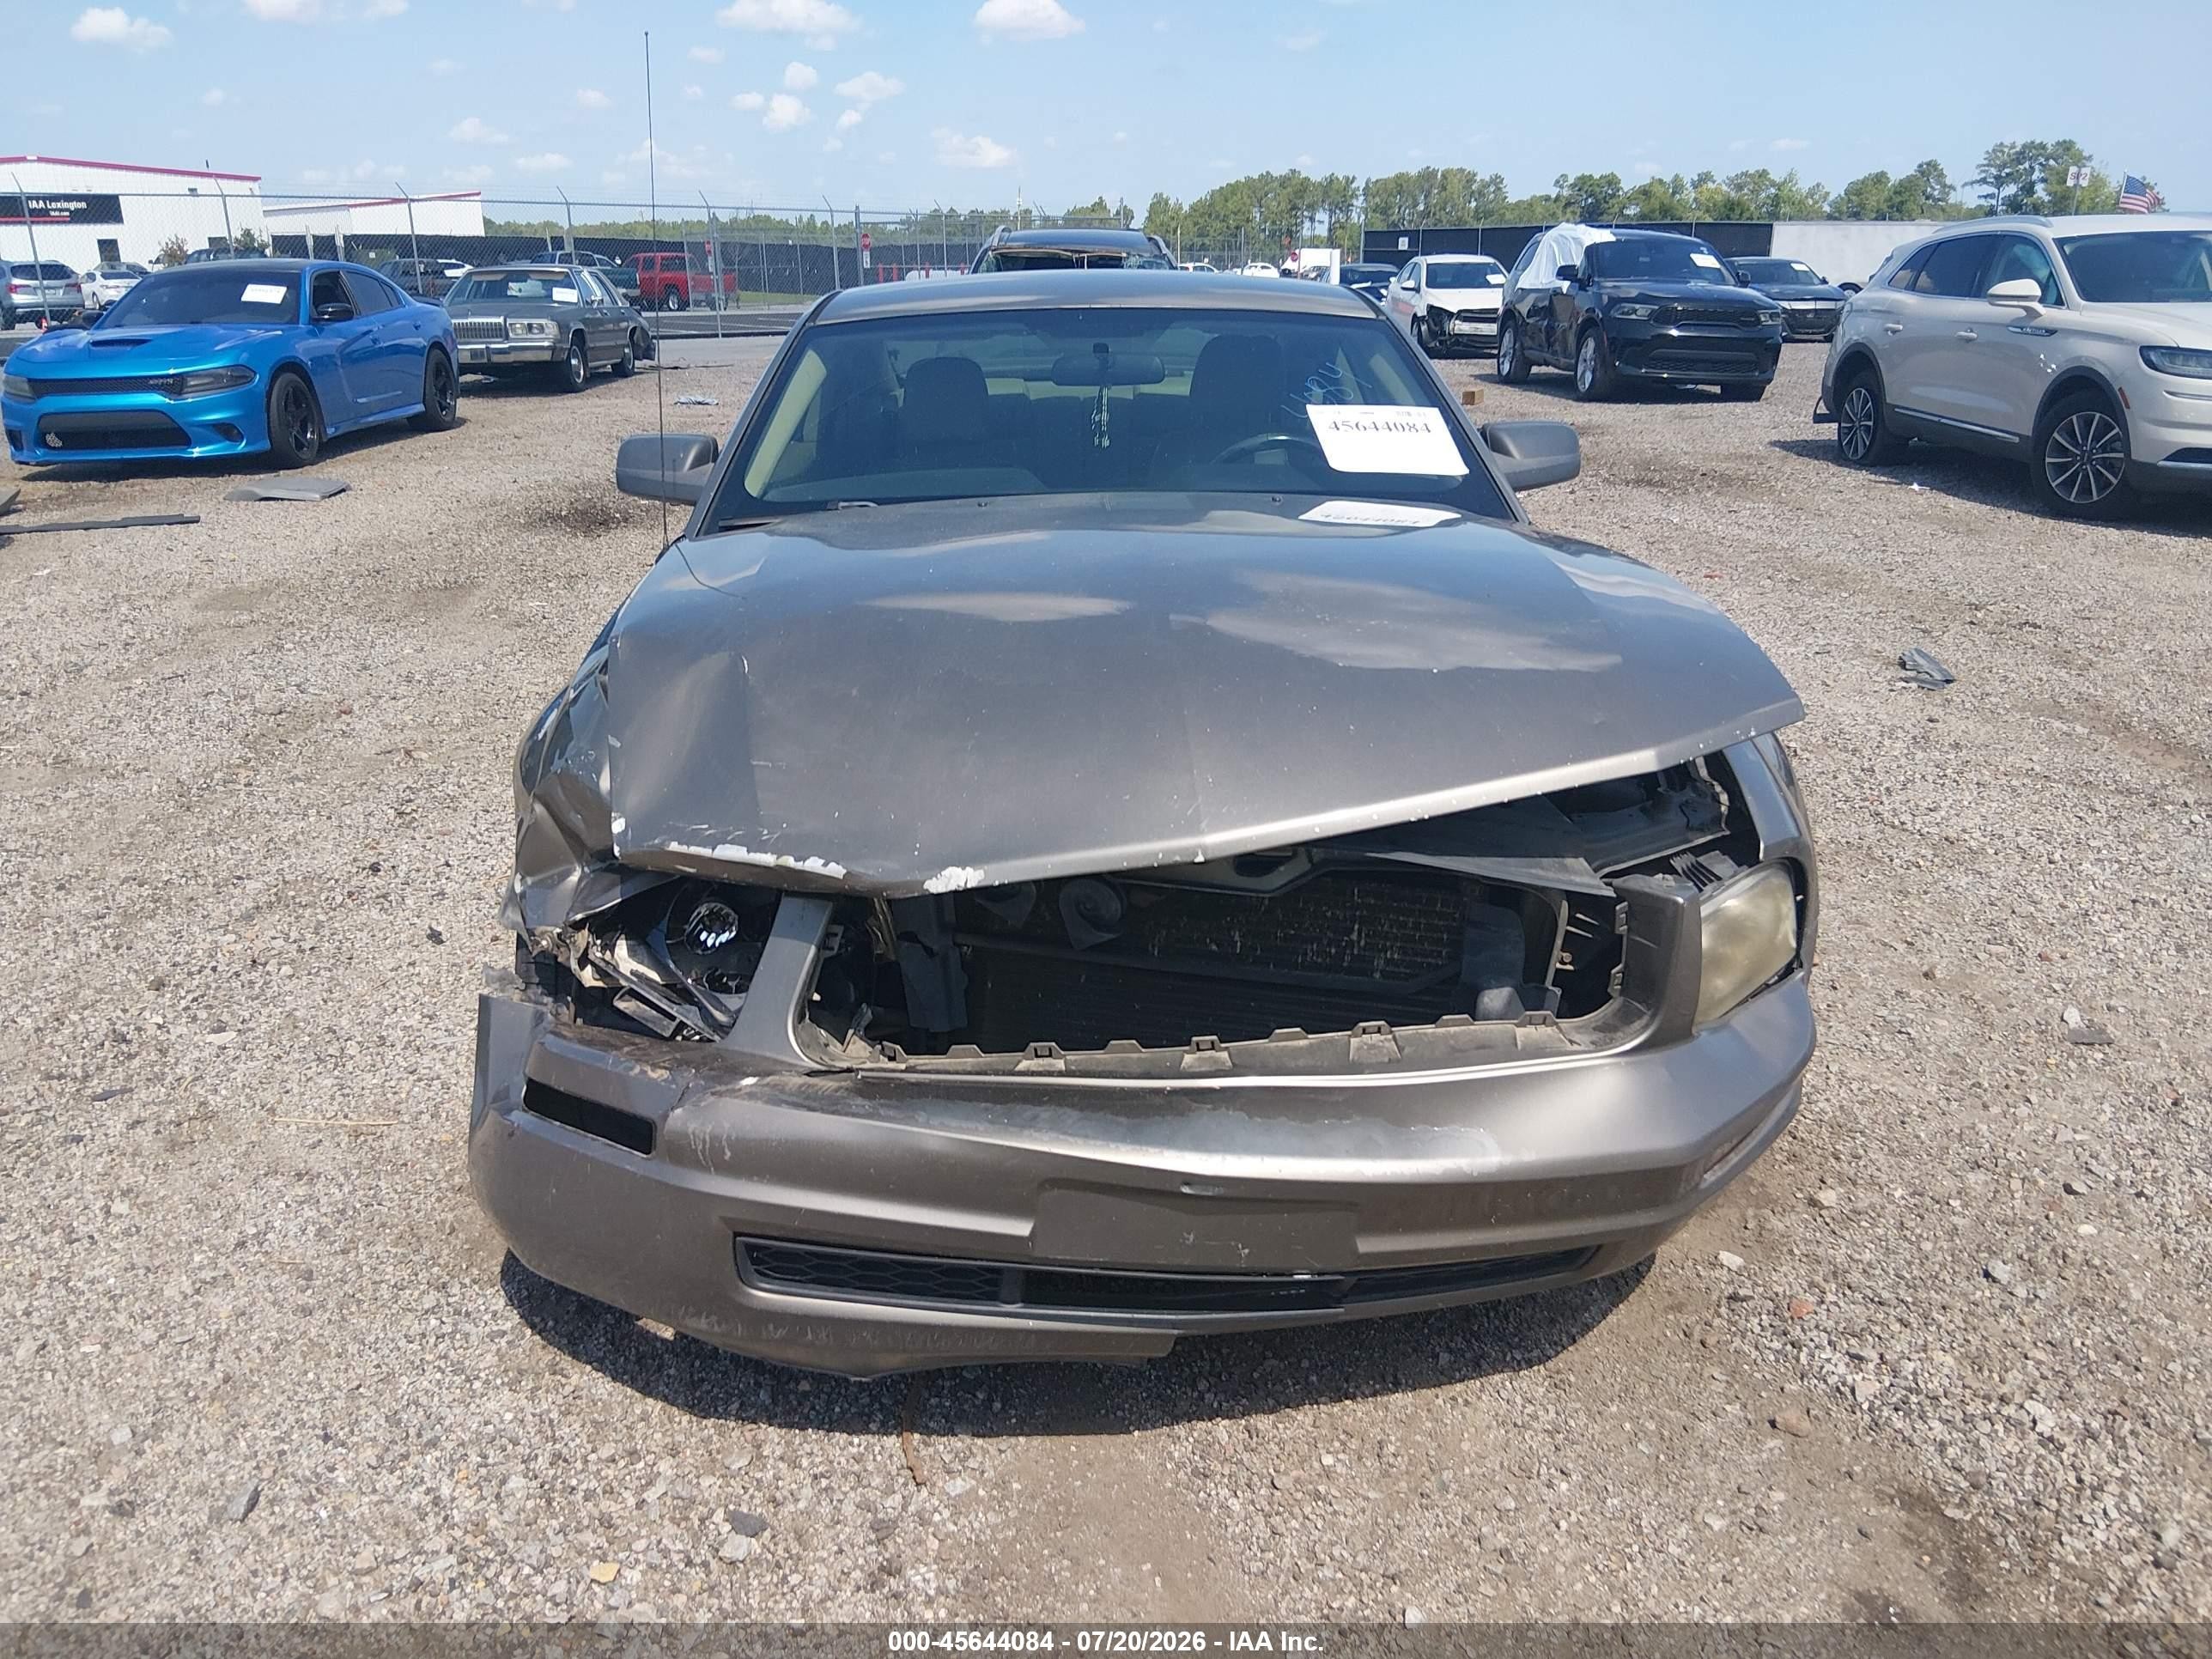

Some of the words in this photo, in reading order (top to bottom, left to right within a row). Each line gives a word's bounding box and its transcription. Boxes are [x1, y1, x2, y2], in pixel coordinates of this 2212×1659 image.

[28, 200, 46, 210] IAA
[46, 200, 87, 210] Lexington
[1328, 420, 1431, 434] 45644084
